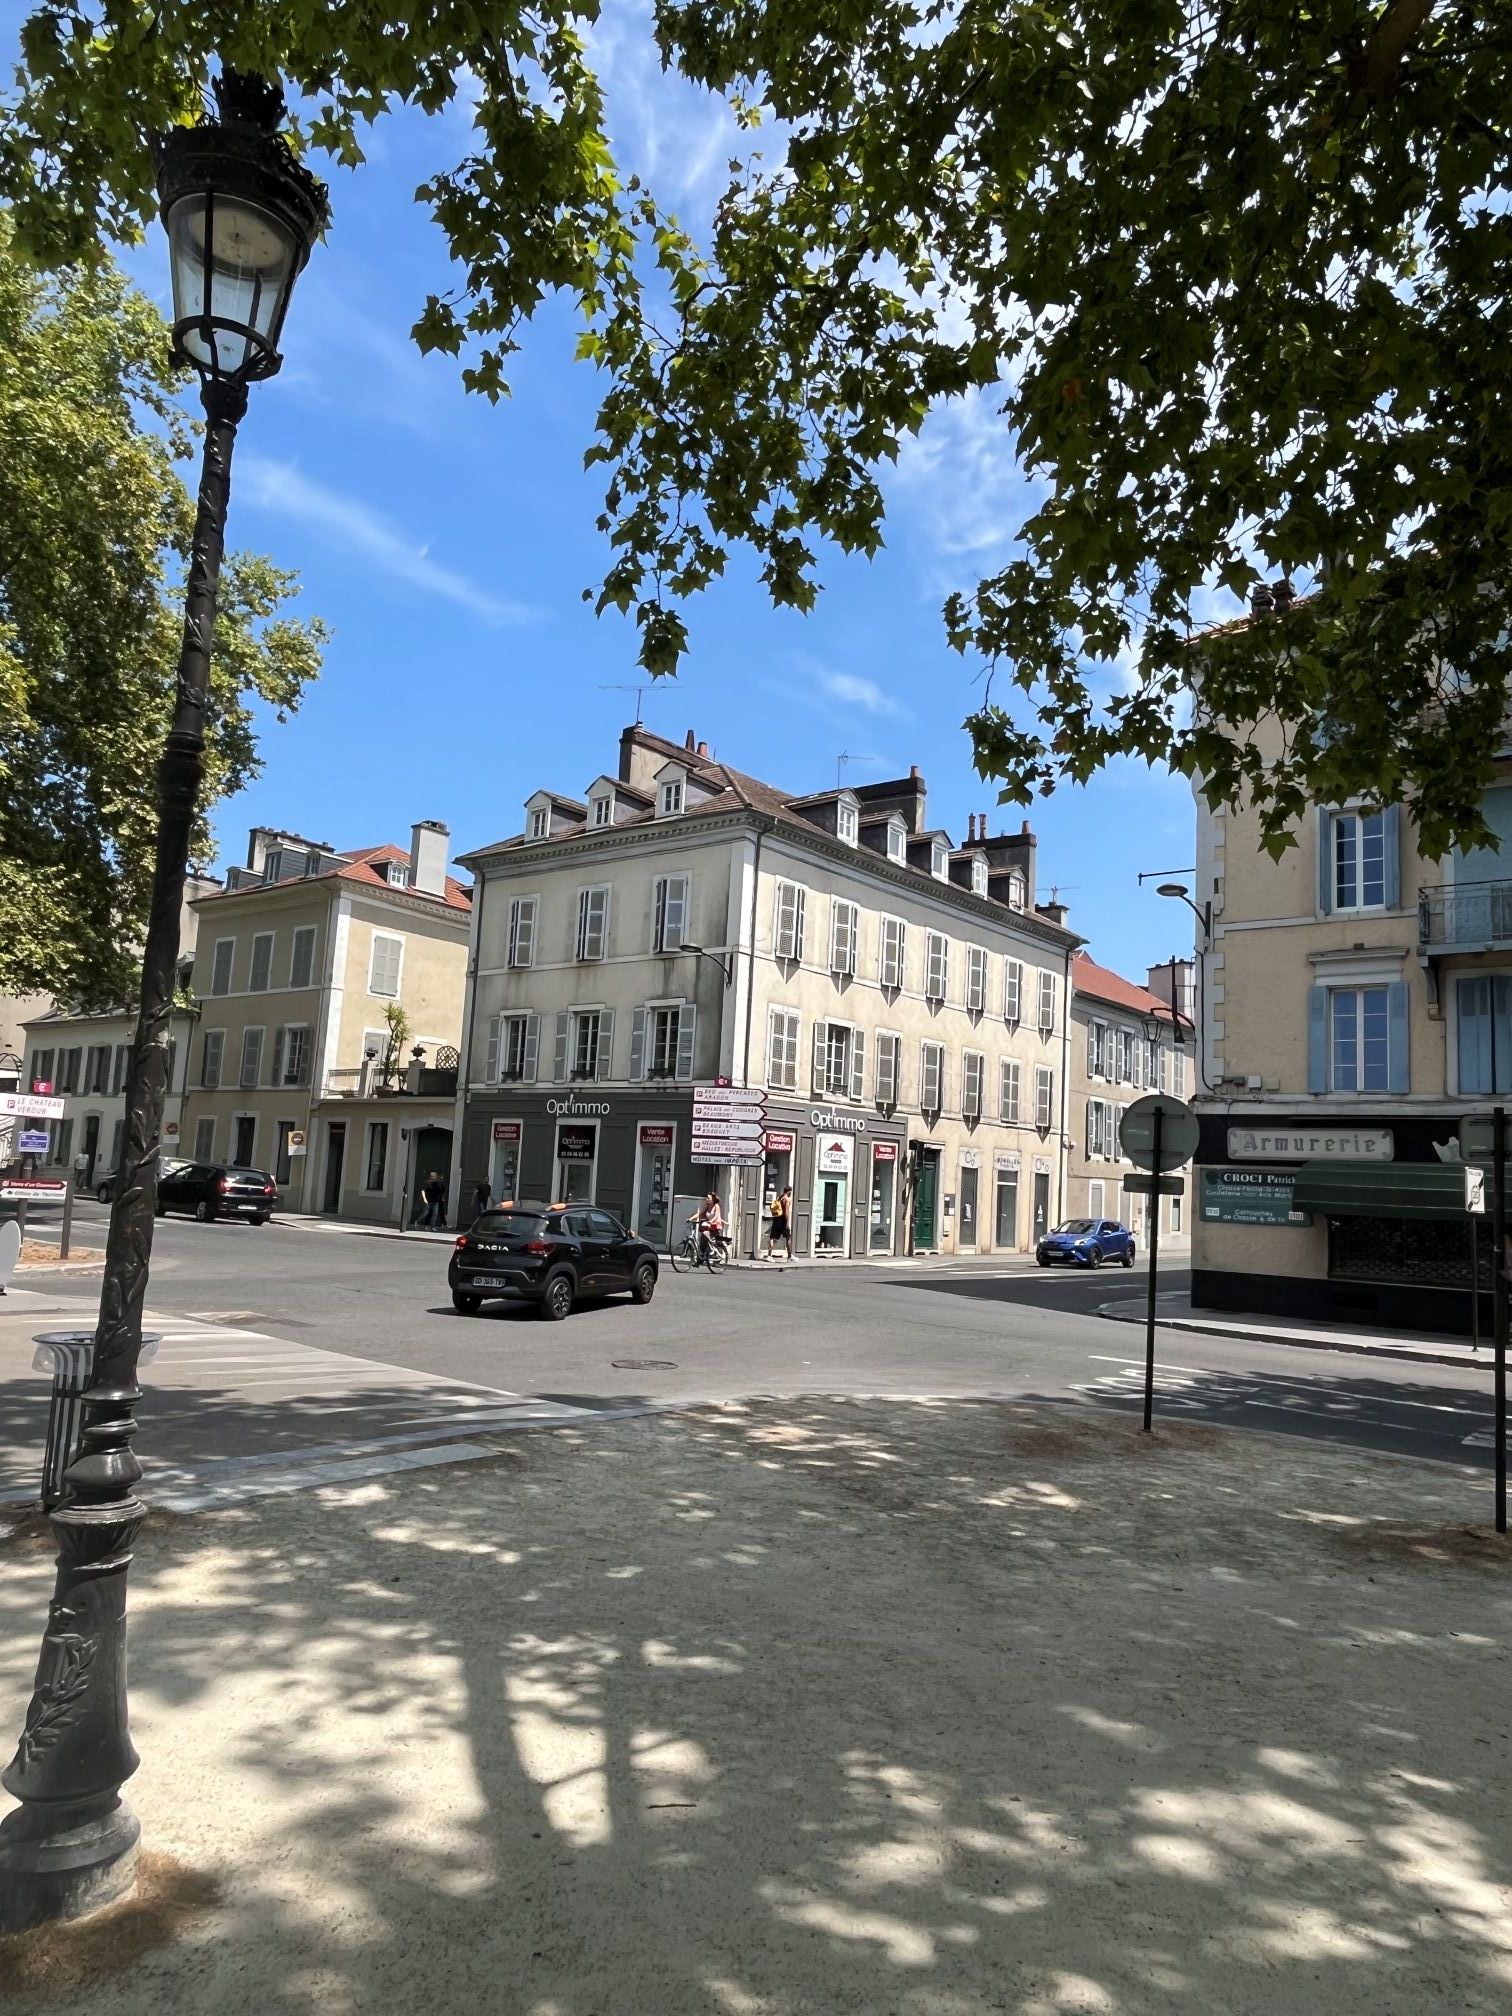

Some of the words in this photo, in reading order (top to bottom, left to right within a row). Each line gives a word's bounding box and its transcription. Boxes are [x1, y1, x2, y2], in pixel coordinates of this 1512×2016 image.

[17, 1106, 47, 1115] VERDUN
[642, 1135, 669, 1143] Location
[1243, 1132, 1376, 1153] Armurerie
[1223, 1173, 1263, 1184] CROCI
[1267, 1174, 1296, 1184] Patrick
[477, 1243, 509, 1252] DACIA
